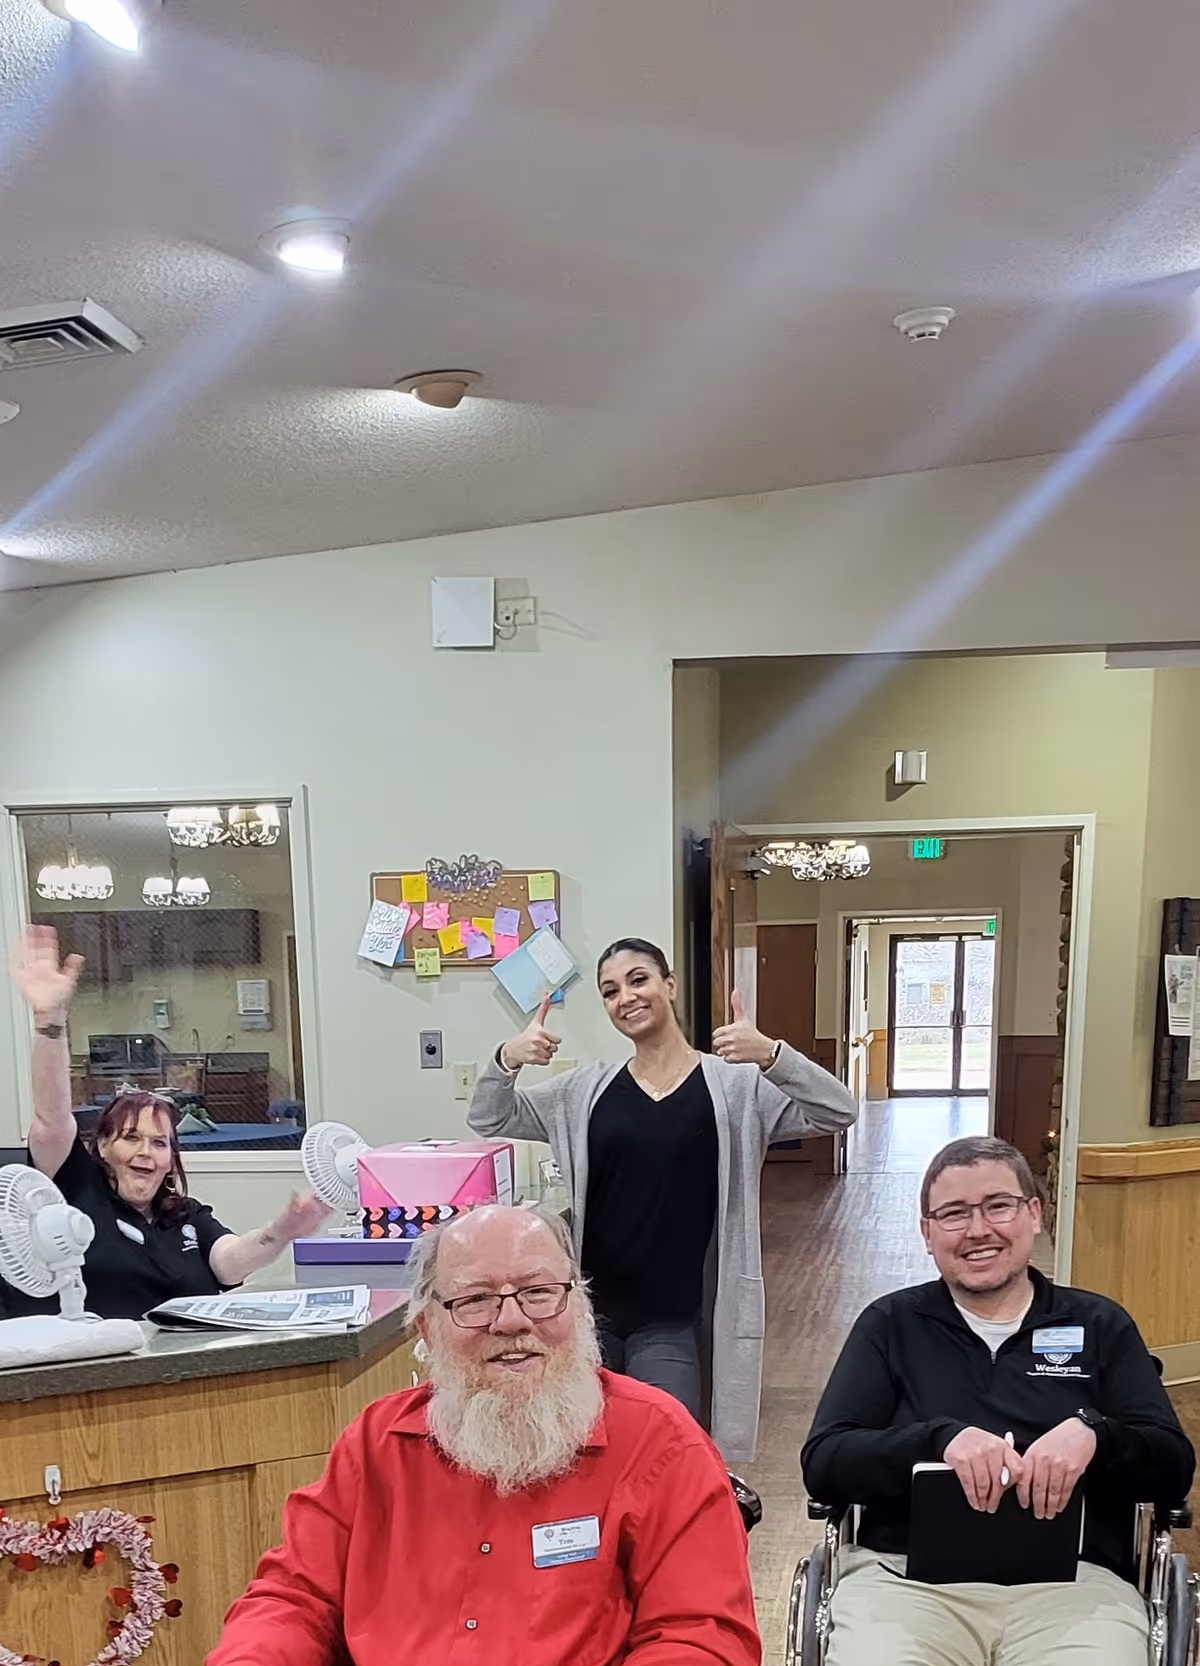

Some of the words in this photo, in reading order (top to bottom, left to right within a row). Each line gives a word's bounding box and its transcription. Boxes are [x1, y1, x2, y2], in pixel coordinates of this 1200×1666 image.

[913, 837, 940, 858] EXIT
[378, 905, 400, 923] We
[1034, 1363, 1081, 1375] Wesleyan
